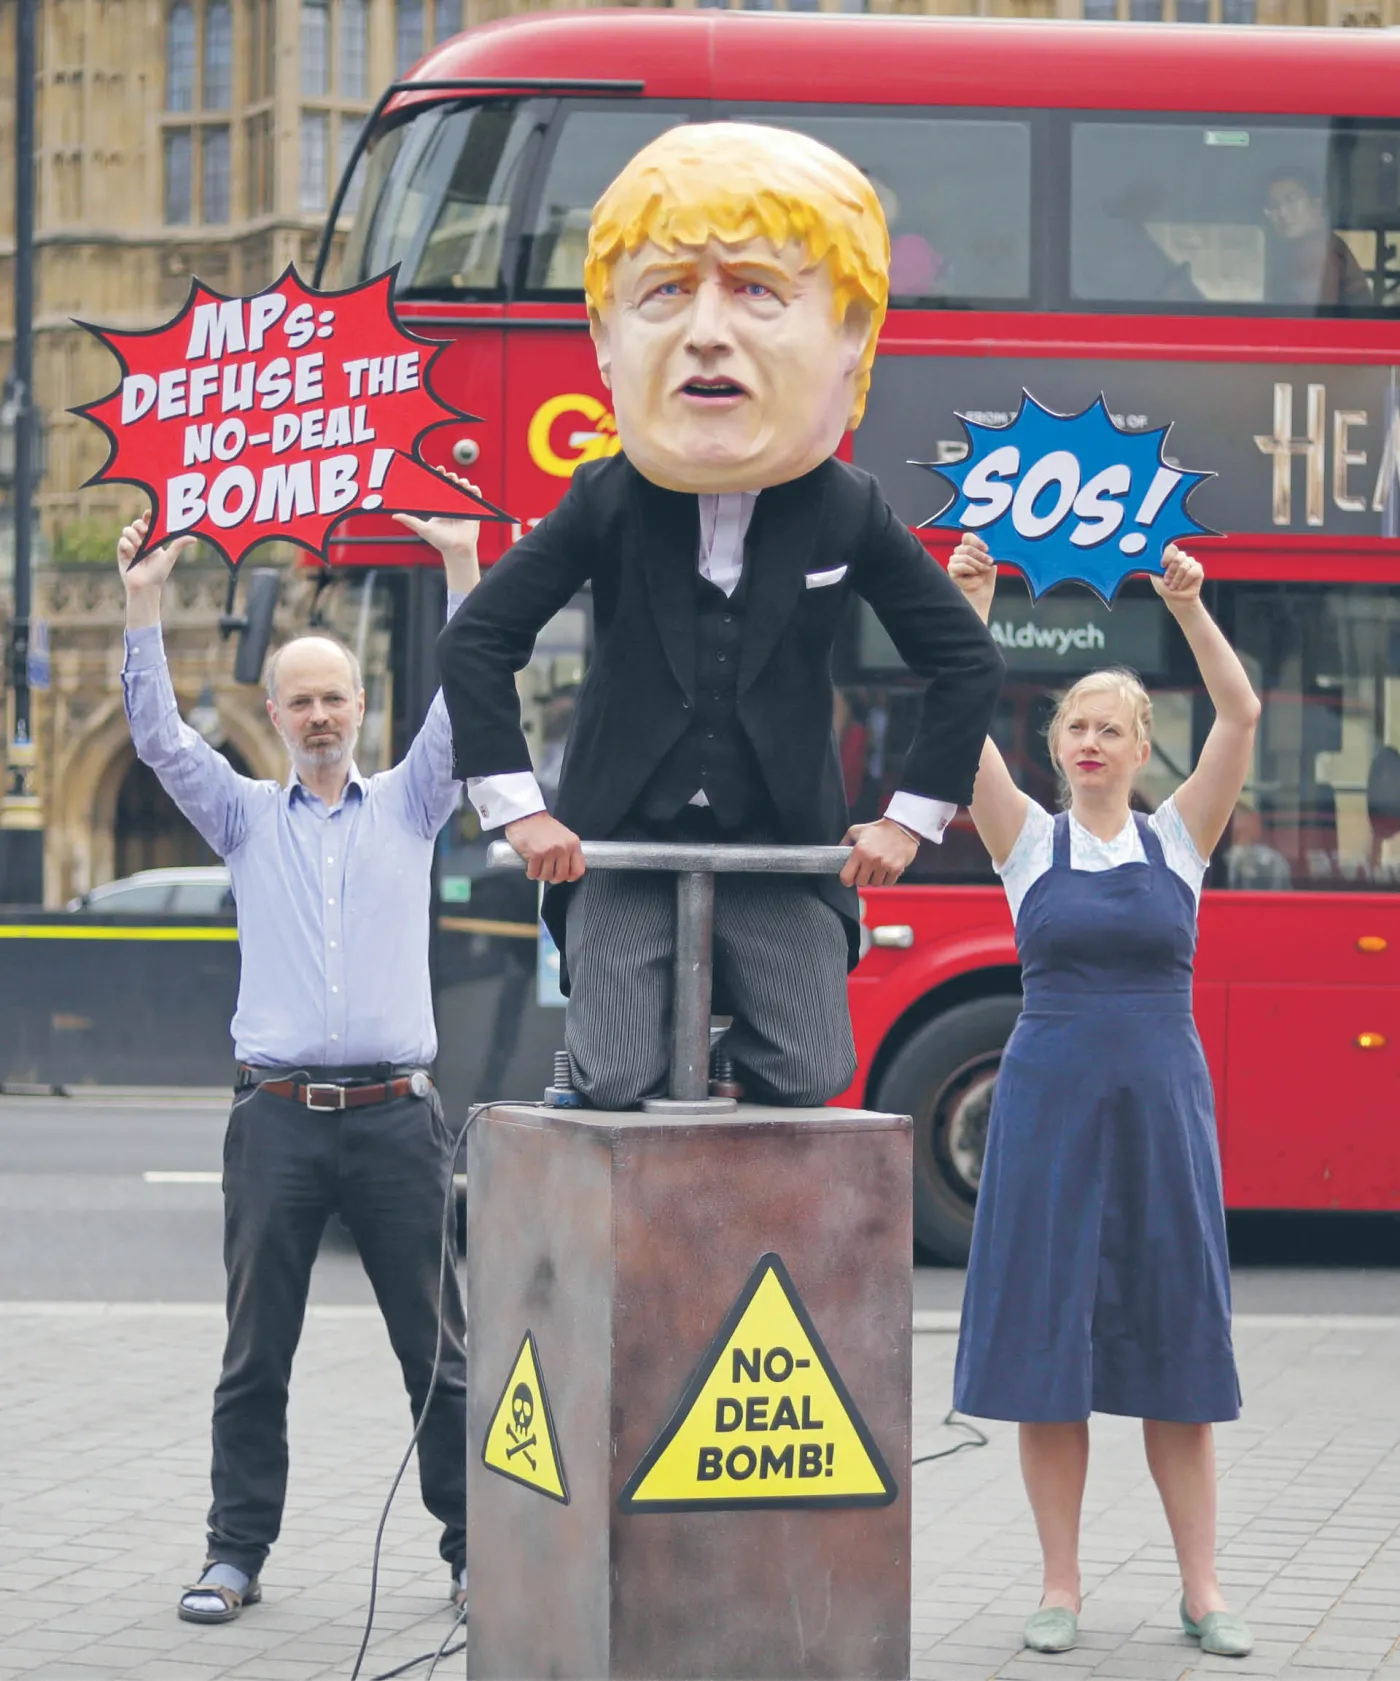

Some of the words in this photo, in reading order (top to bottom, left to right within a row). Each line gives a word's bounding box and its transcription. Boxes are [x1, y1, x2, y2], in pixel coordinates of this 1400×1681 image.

[186, 293, 335, 360] MPs:
[121, 352, 325, 426] DEFUSE
[342, 351, 420, 398] THE
[183, 404, 375, 467] NO-DEAL
[166, 448, 396, 533] BOMB!
[959, 445, 1184, 555] SOS!
[989, 620, 1105, 656] Aldwych
[731, 1346, 811, 1384] NO-
[715, 1395, 824, 1433] DEAL
[696, 1442, 835, 1482] BOMB!
